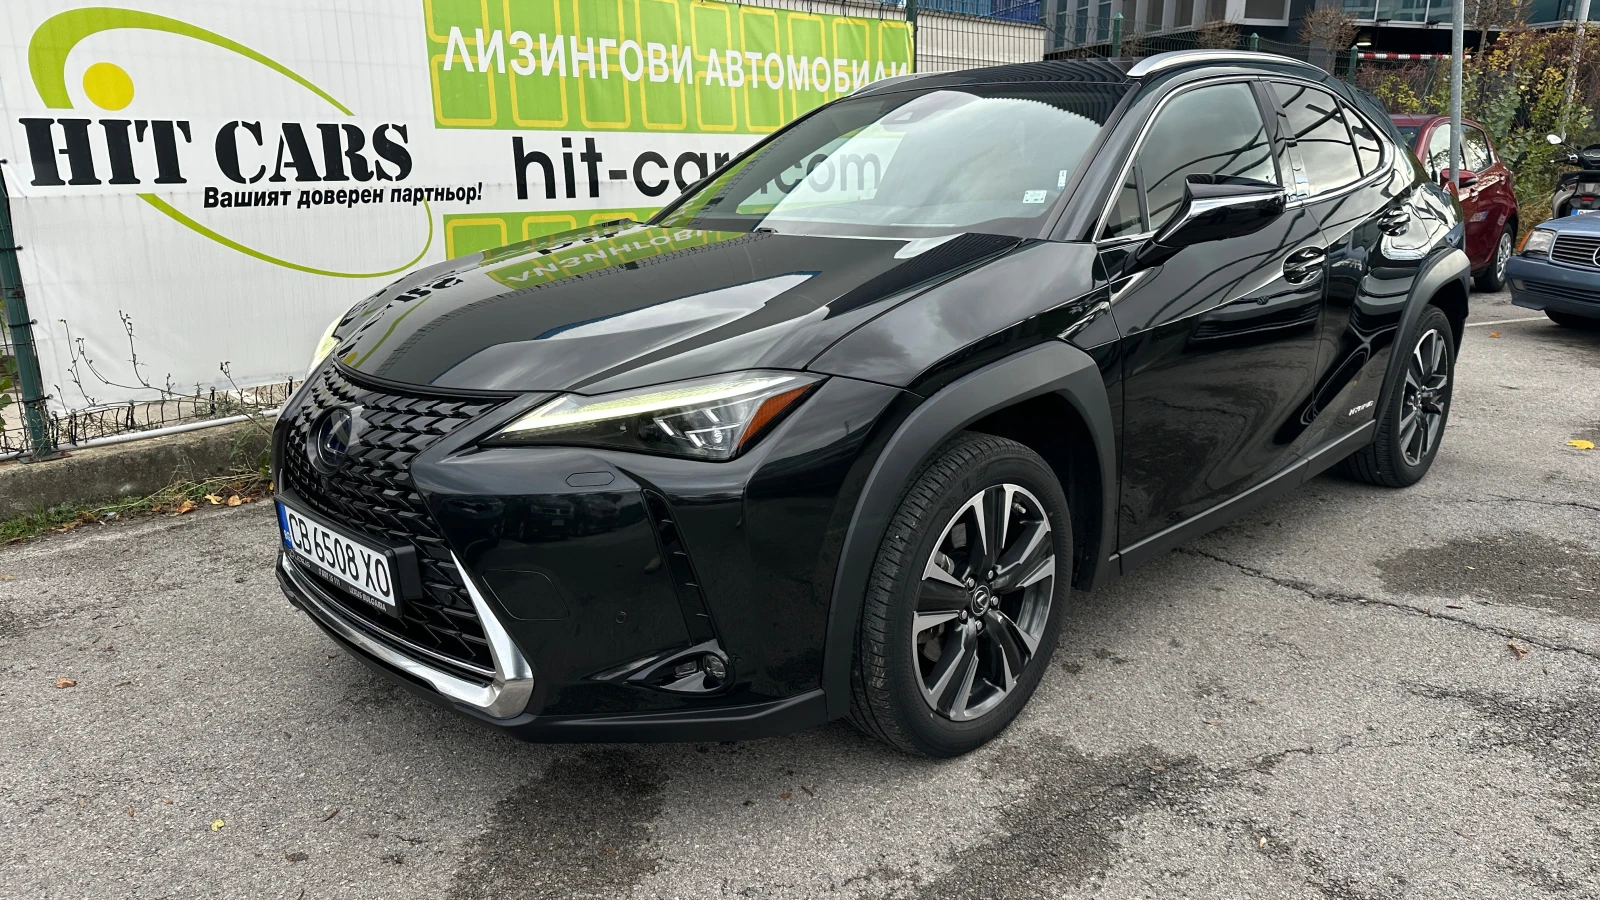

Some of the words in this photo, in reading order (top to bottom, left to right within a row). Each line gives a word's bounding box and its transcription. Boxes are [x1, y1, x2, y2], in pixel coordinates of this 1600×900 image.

[443, 26, 693, 85] ЛИЗИНГОВИ
[19, 117, 192, 186] HIT
[215, 121, 413, 184] CARS
[203, 186, 291, 208] Вашият
[297, 187, 384, 209] доверен
[390, 182, 483, 205] партньор!
